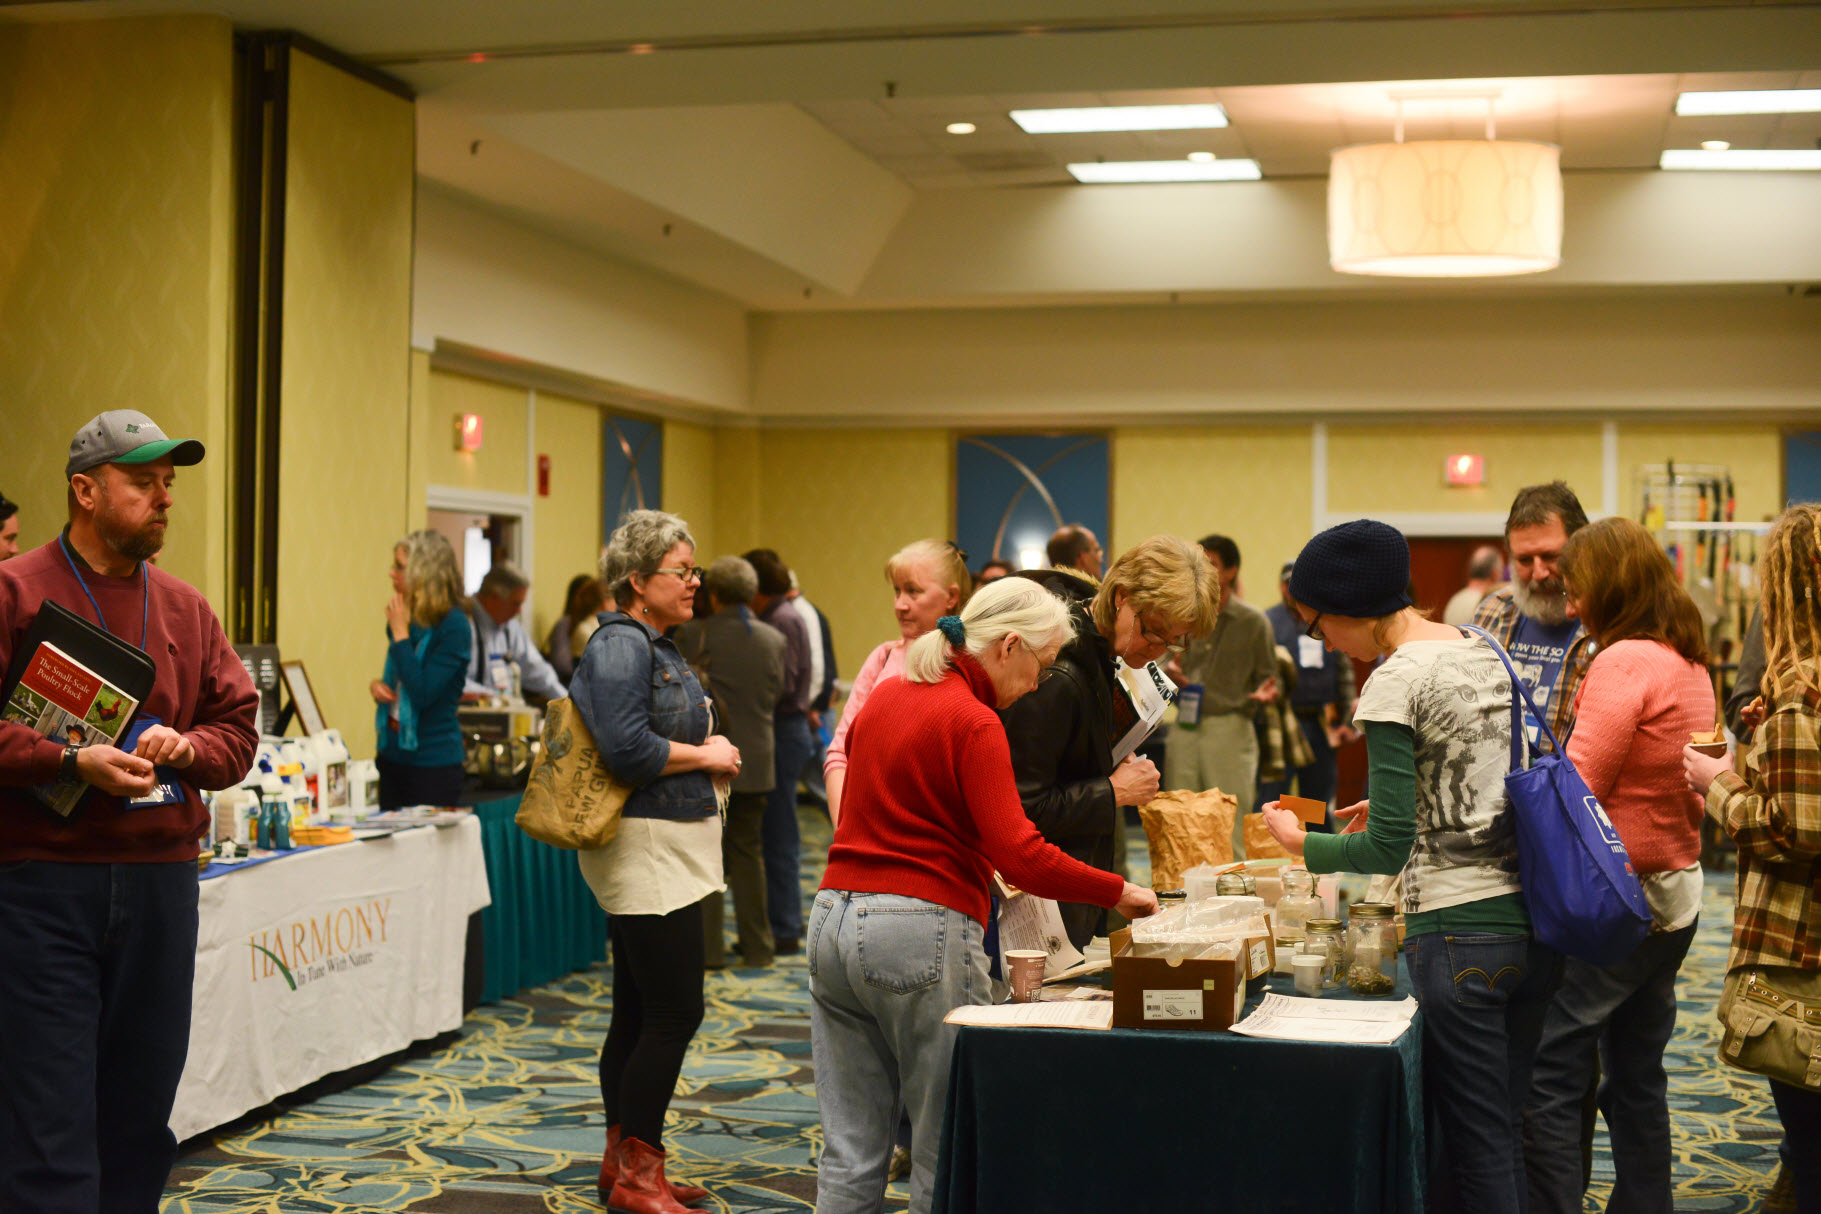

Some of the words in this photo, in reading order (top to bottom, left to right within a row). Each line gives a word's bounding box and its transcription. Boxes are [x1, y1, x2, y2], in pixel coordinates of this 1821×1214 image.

[1531, 644, 1550, 656] THE
[1550, 647, 1564, 657] SO
[37, 668, 62, 690] Poultry
[63, 683, 83, 701] Flock
[39, 656, 52, 671] The
[51, 665, 91, 695] Small-Scale
[565, 748, 594, 810] PAPUA
[249, 897, 392, 983] HARMONY
[297, 970, 306, 987] In
[308, 965, 326, 982] Tune
[326, 956, 347, 973] With
[349, 952, 374, 967] Nature
